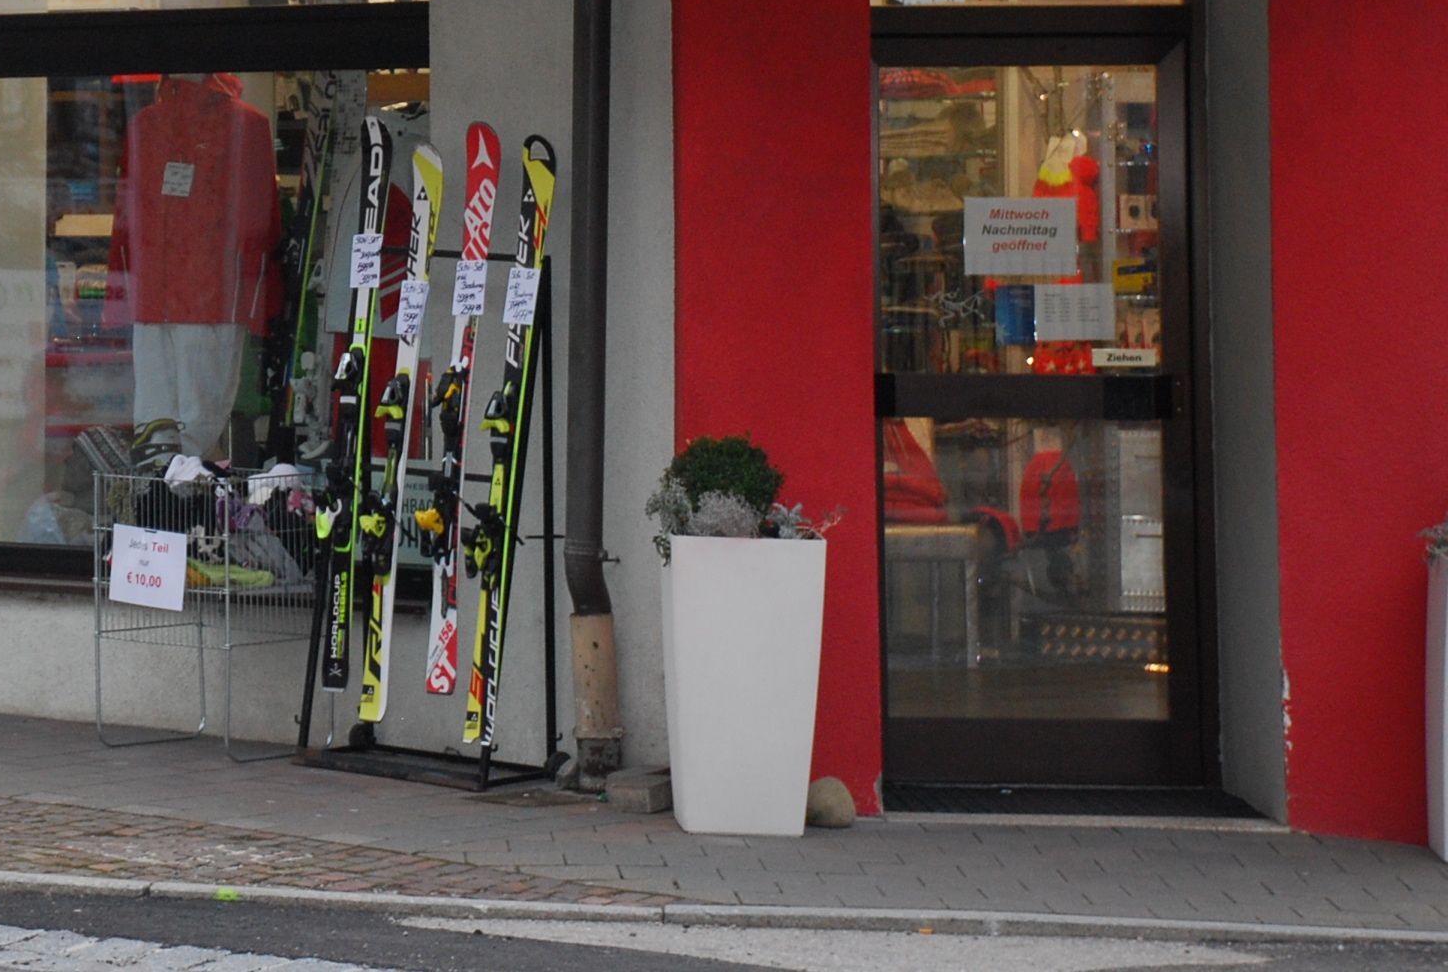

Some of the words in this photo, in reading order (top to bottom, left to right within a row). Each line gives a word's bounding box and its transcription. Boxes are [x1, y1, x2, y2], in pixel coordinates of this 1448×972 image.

[364, 145, 383, 235] EAD
[989, 208, 1050, 220] Mittwoch
[982, 224, 1058, 238] Nachmittag
[992, 239, 1048, 253] geöffnet
[1106, 353, 1142, 363] Ziehen
[152, 541, 169, 553] Teil
[126, 571, 133, 583] €
[135, 573, 162, 588] 10,00
[330, 574, 341, 659] WORLDCUP
